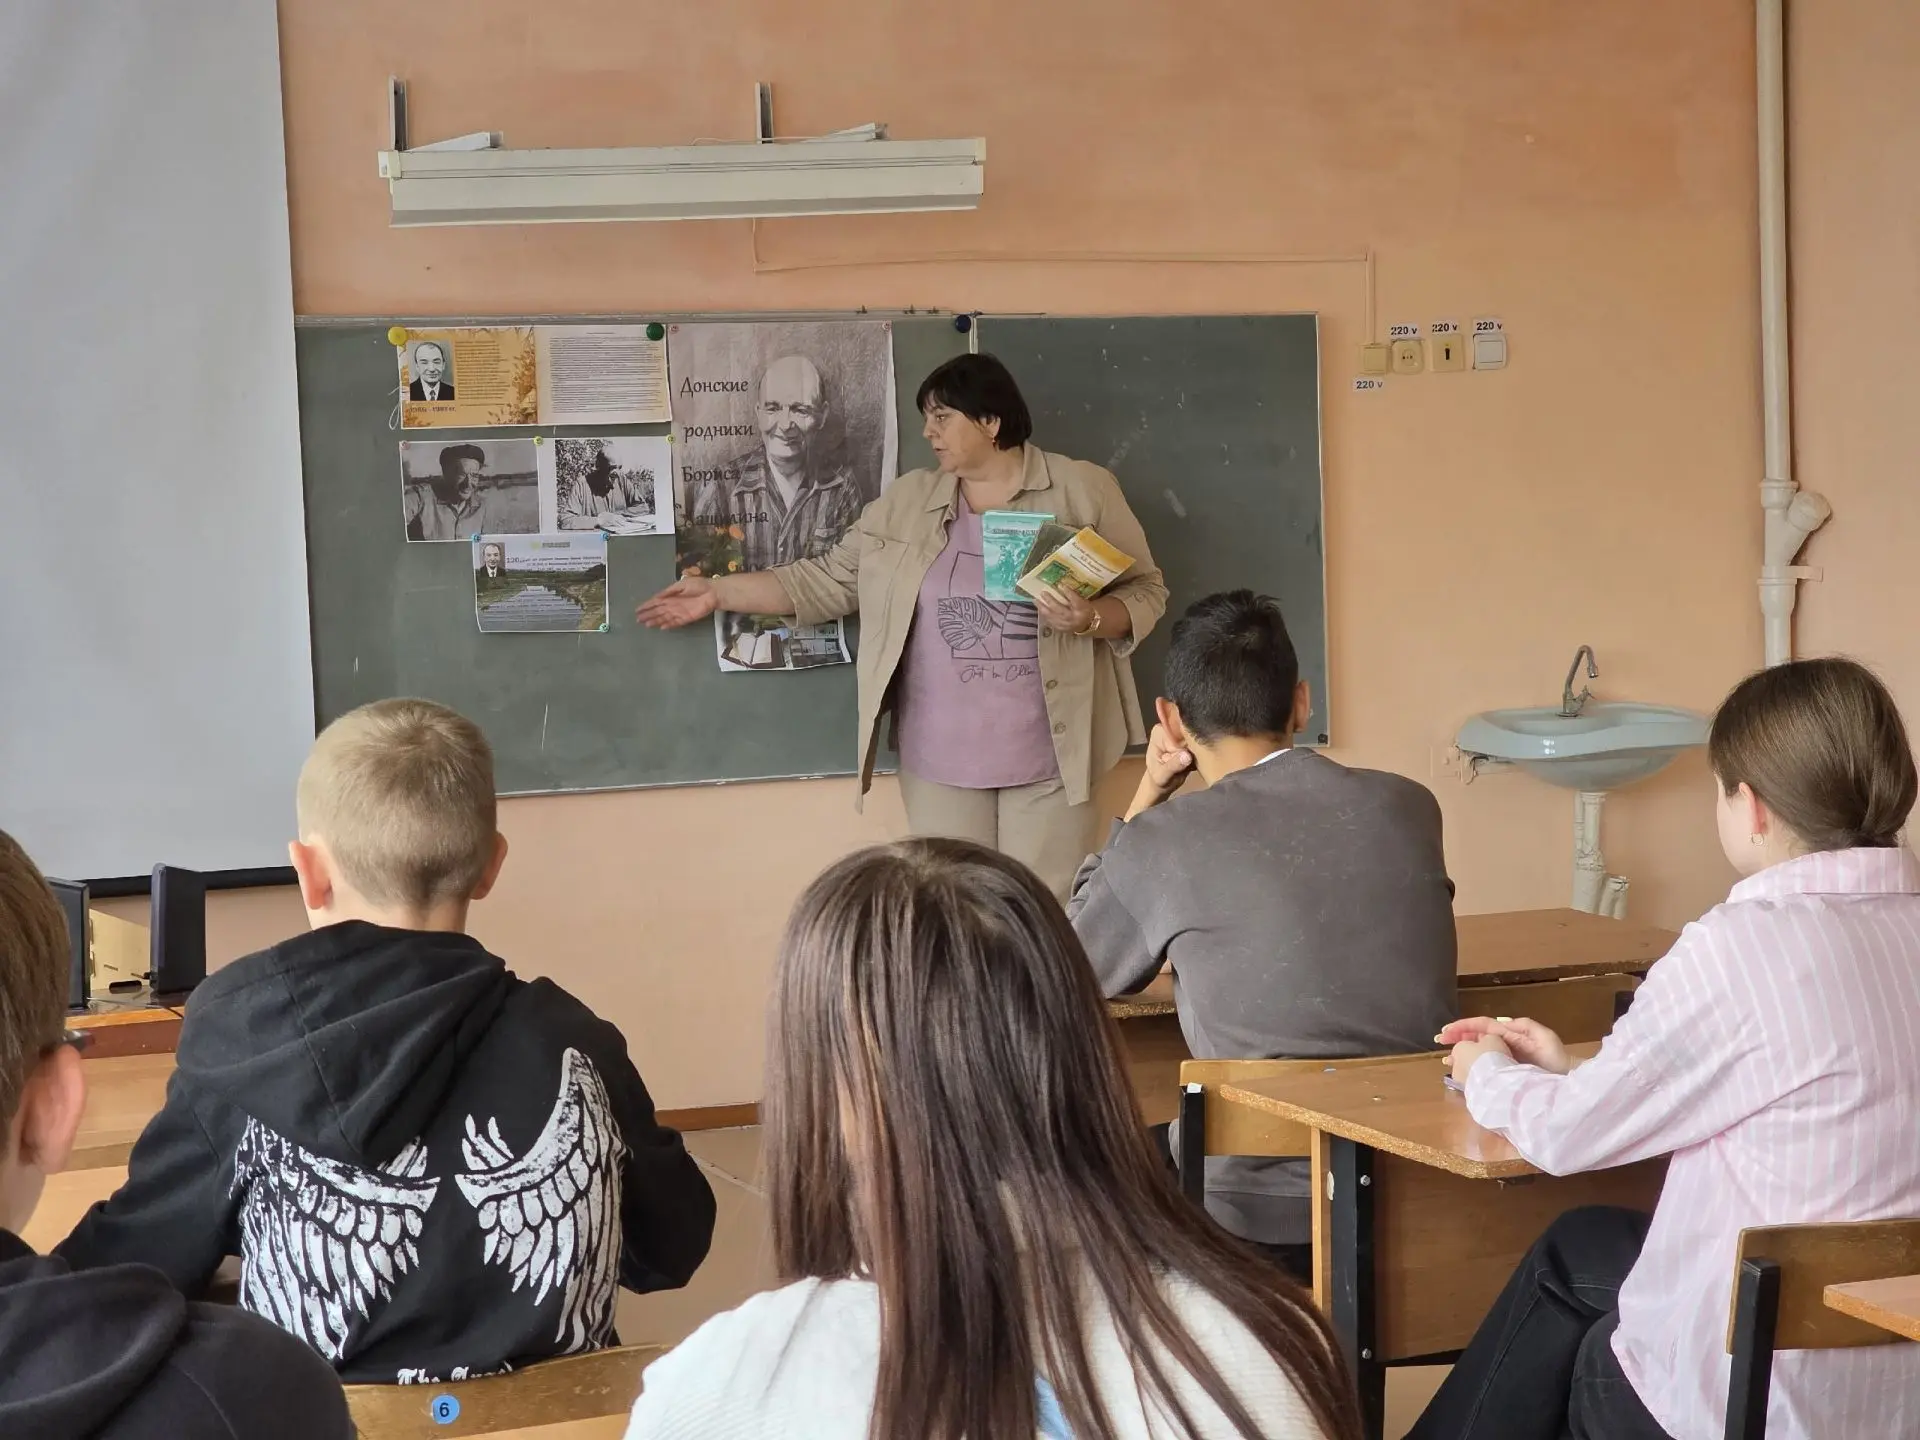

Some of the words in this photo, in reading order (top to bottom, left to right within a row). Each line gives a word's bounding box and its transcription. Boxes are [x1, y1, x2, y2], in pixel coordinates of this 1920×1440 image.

[1391, 326, 1409, 336] 220
[1432, 323, 1450, 333] 220
[1477, 321, 1494, 331] 220
[680, 376, 749, 398] Донские
[1356, 381, 1375, 389] 220
[683, 425, 754, 444] родники
[681, 465, 741, 487] Бориса
[439, 1402, 450, 1417] 6
